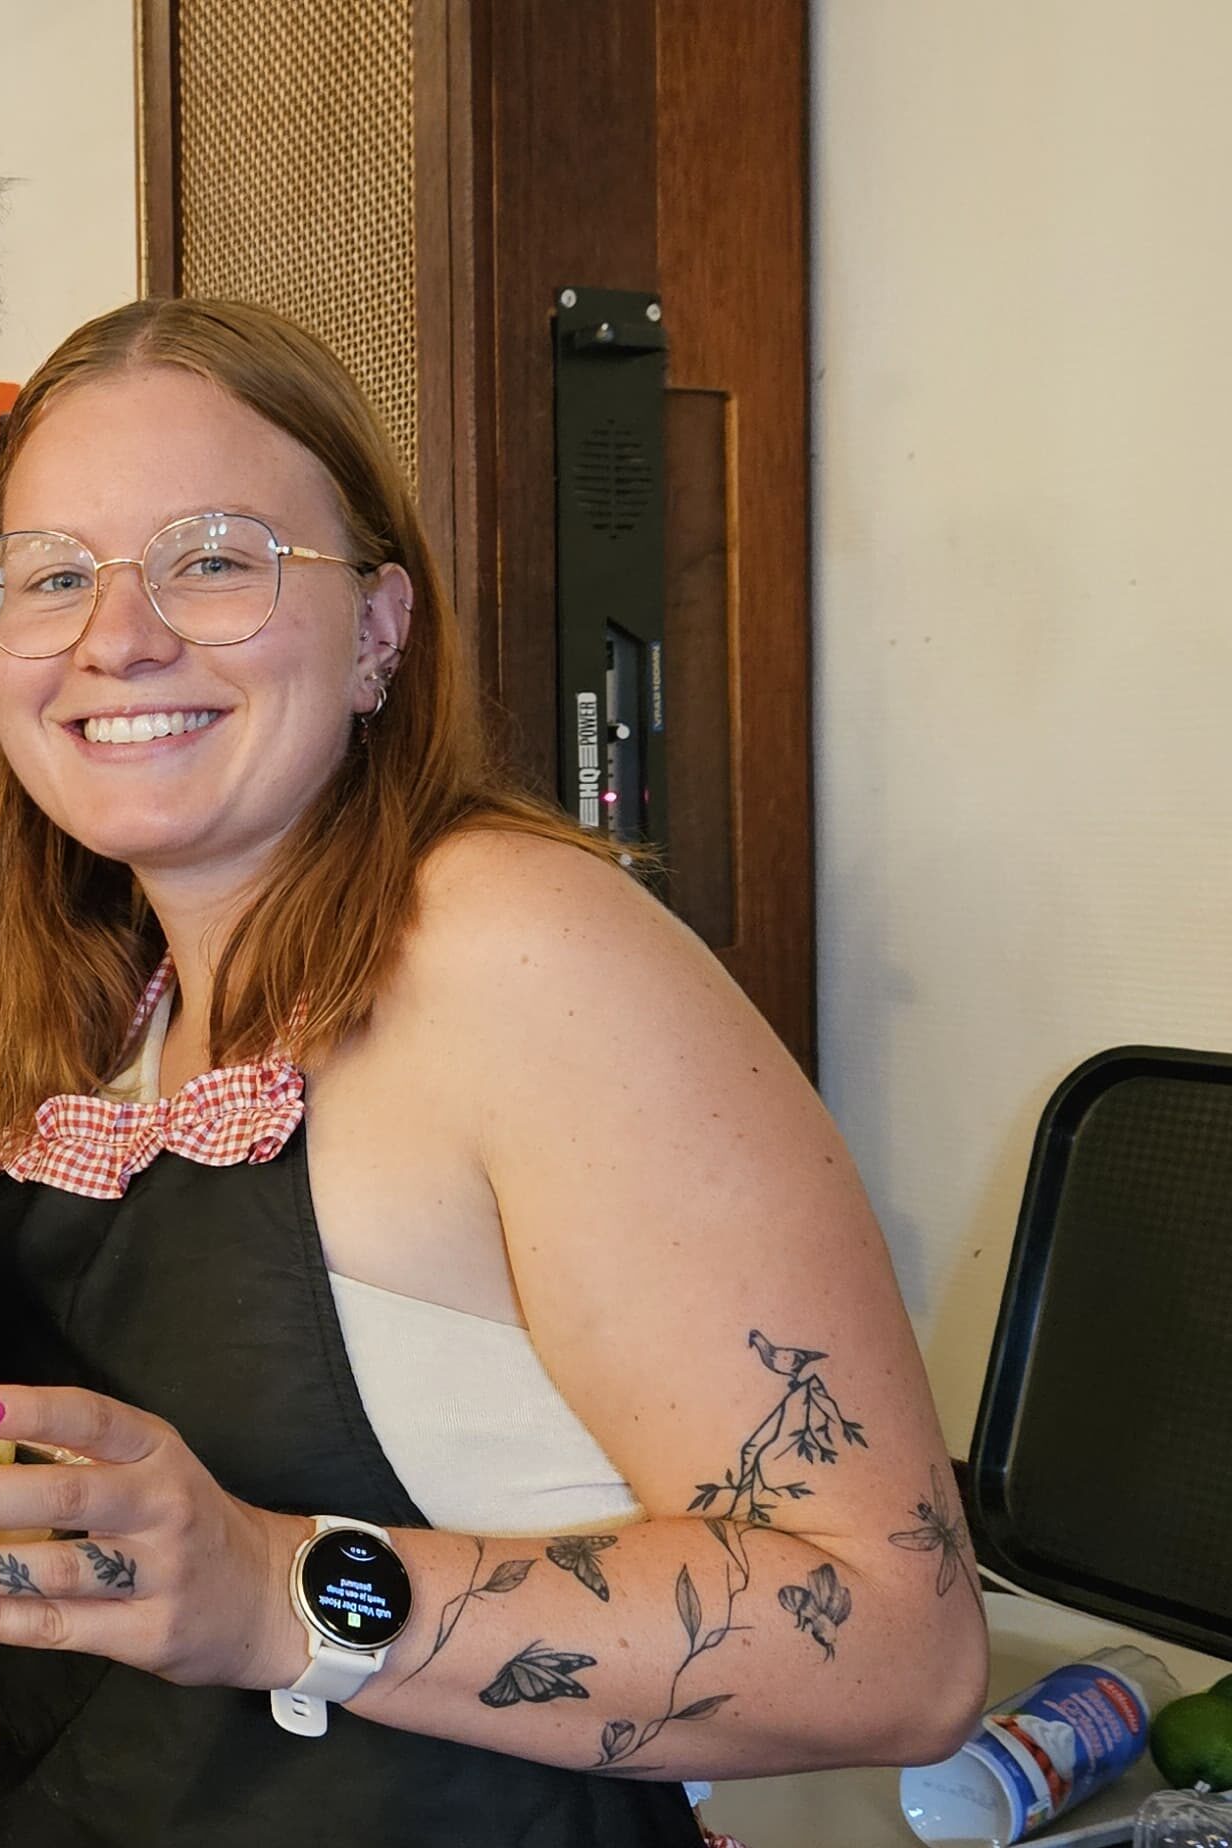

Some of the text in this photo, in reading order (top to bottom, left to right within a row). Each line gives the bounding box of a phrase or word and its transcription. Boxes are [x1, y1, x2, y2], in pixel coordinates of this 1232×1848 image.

[579, 702, 601, 798] HQ POWER
[358, 1605, 374, 1616] Van
